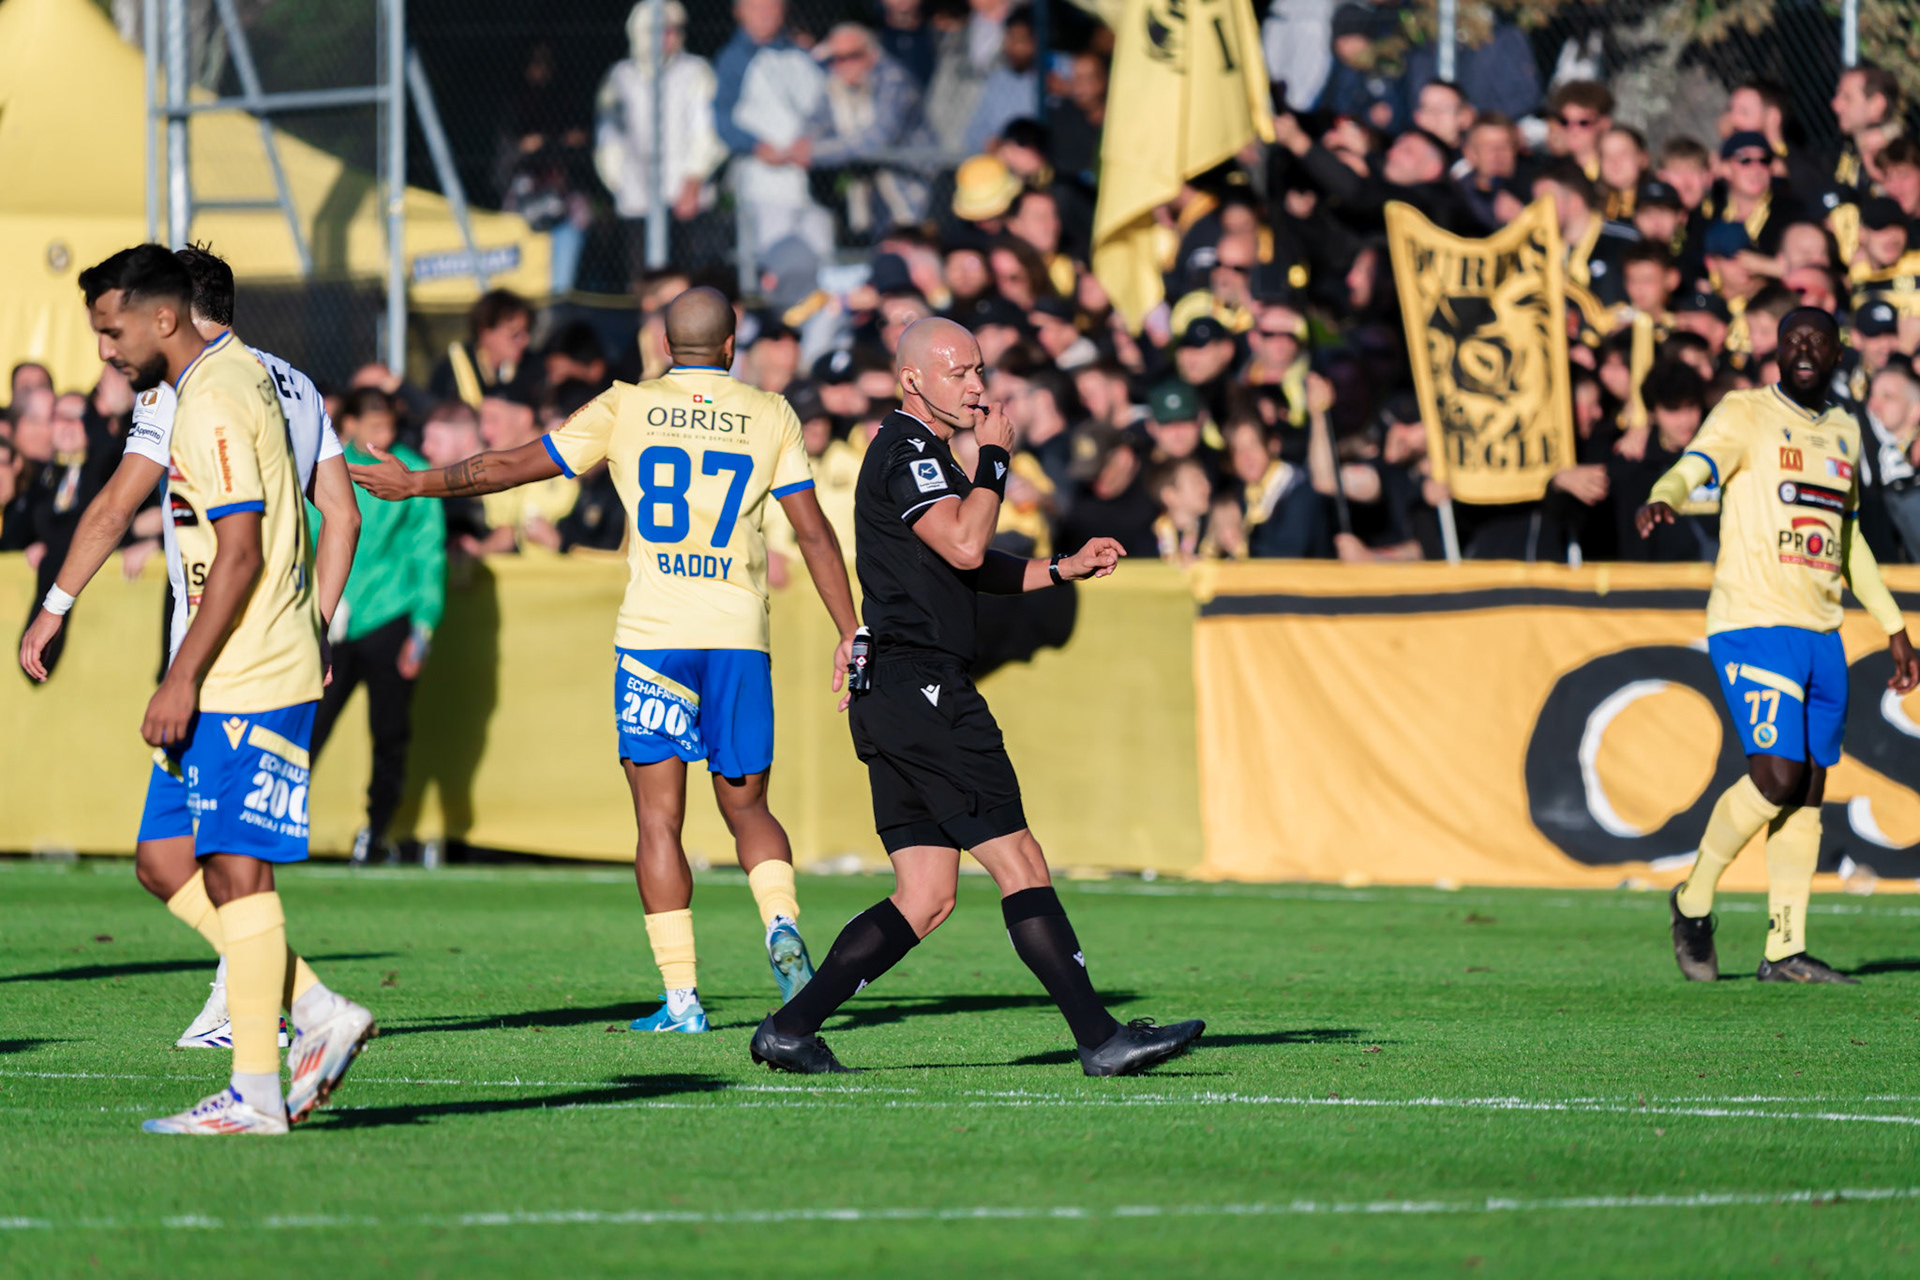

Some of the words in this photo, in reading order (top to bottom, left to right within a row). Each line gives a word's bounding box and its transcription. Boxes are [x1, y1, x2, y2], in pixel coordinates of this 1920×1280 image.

[647, 406, 752, 434] OBRIST
[637, 445, 754, 548] 87
[657, 553, 733, 580] BADDY
[1744, 689, 1781, 725] 77
